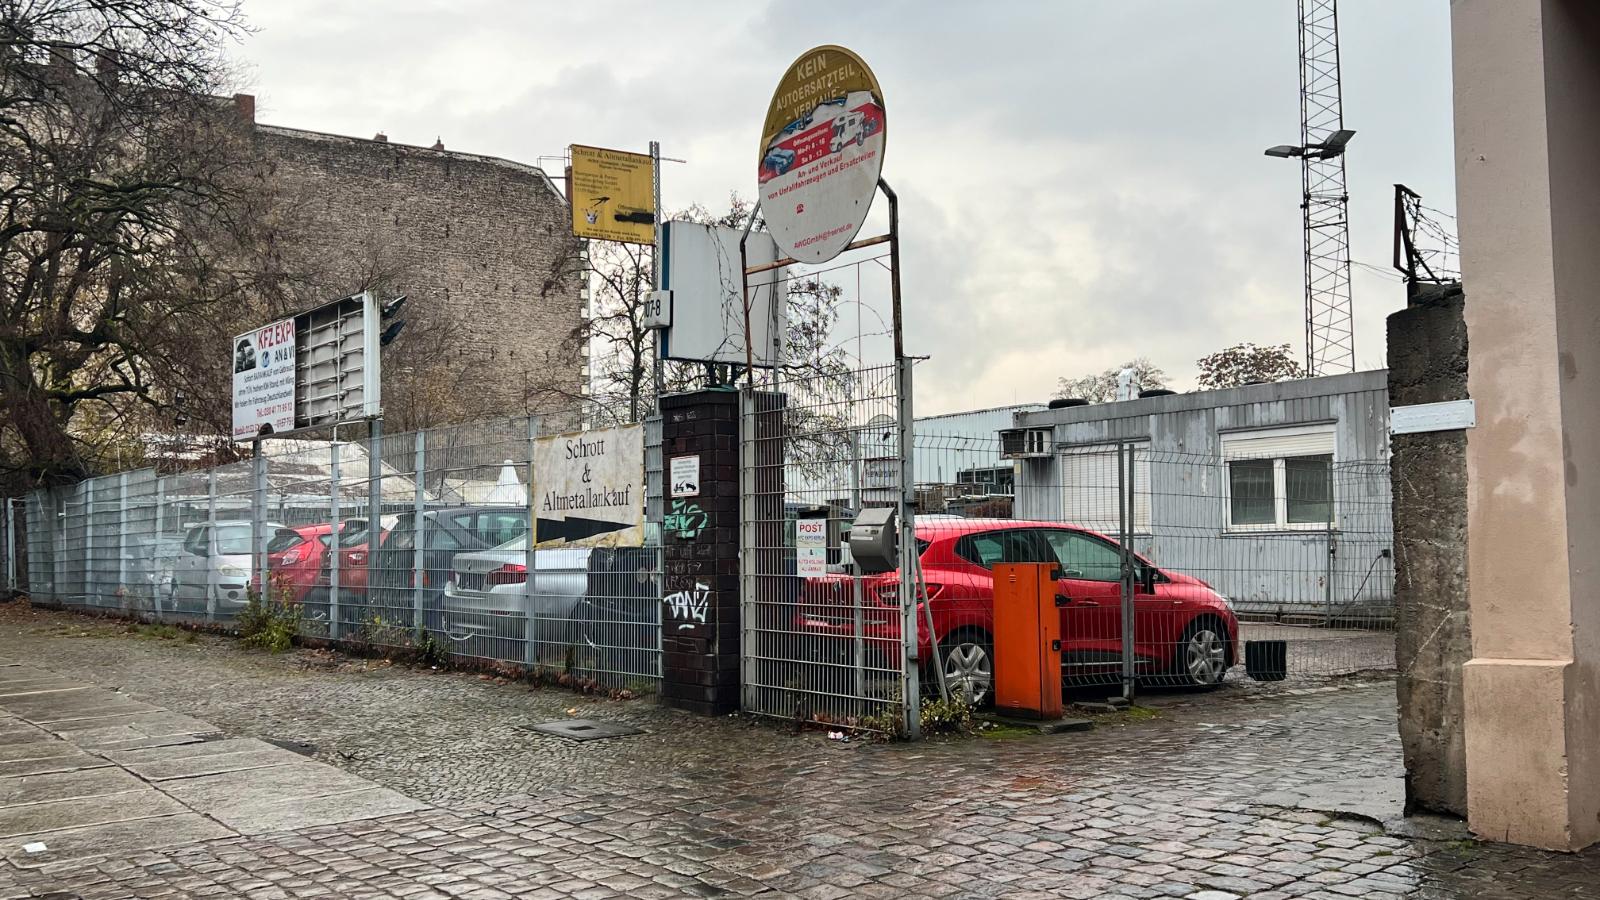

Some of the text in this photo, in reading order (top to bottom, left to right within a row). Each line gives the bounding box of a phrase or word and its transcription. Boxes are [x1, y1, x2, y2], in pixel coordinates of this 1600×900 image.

[797, 54, 826, 81] KEIN
[777, 64, 855, 111] AUTOERSATZTEIL
[808, 164, 819, 175] und
[820, 152, 843, 169] Verkauf
[768, 191, 778, 200] von
[779, 171, 827, 196] Unfallfahrzeugen
[828, 165, 838, 175] und
[258, 328, 274, 351] KFZ
[275, 349, 283, 363] AN
[284, 347, 288, 360] &
[565, 436, 605, 459] Schrott
[581, 462, 592, 483] &
[542, 484, 632, 511] Altmetallankauf
[799, 524, 823, 533] POST
